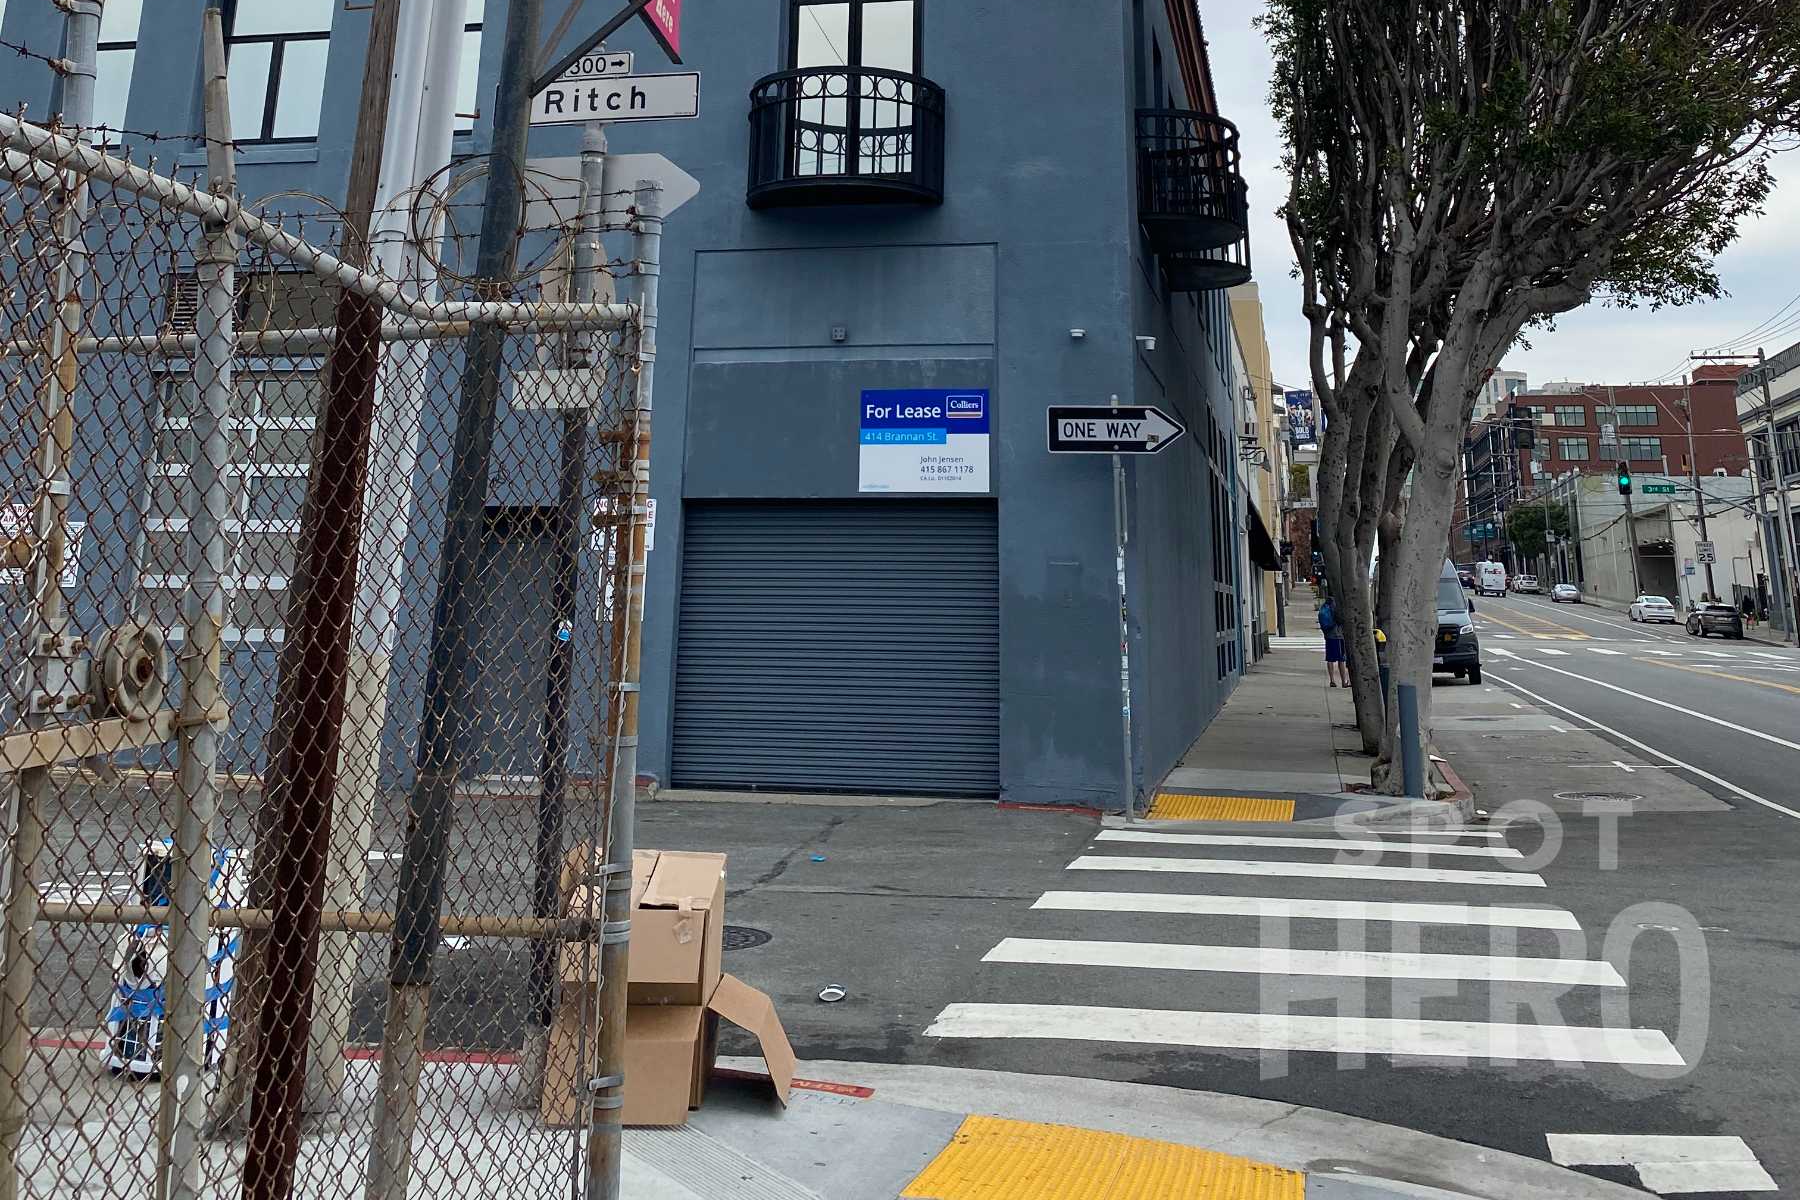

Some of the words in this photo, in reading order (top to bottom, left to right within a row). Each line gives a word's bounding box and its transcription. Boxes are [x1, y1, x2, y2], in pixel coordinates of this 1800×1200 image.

[569, 56, 607, 75] 300
[544, 85, 647, 115] Ritch
[950, 400, 979, 409] Colliers
[866, 404, 892, 419] For
[896, 404, 942, 419] Lease
[1062, 422, 1097, 438] ONE
[1105, 422, 1142, 439] WAY
[865, 432, 882, 441] 414
[884, 432, 925, 441] Brannan
[920, 455, 938, 465] John
[938, 455, 964, 465] Jensen
[920, 465, 935, 473] 415
[1698, 553, 1714, 562] 25
